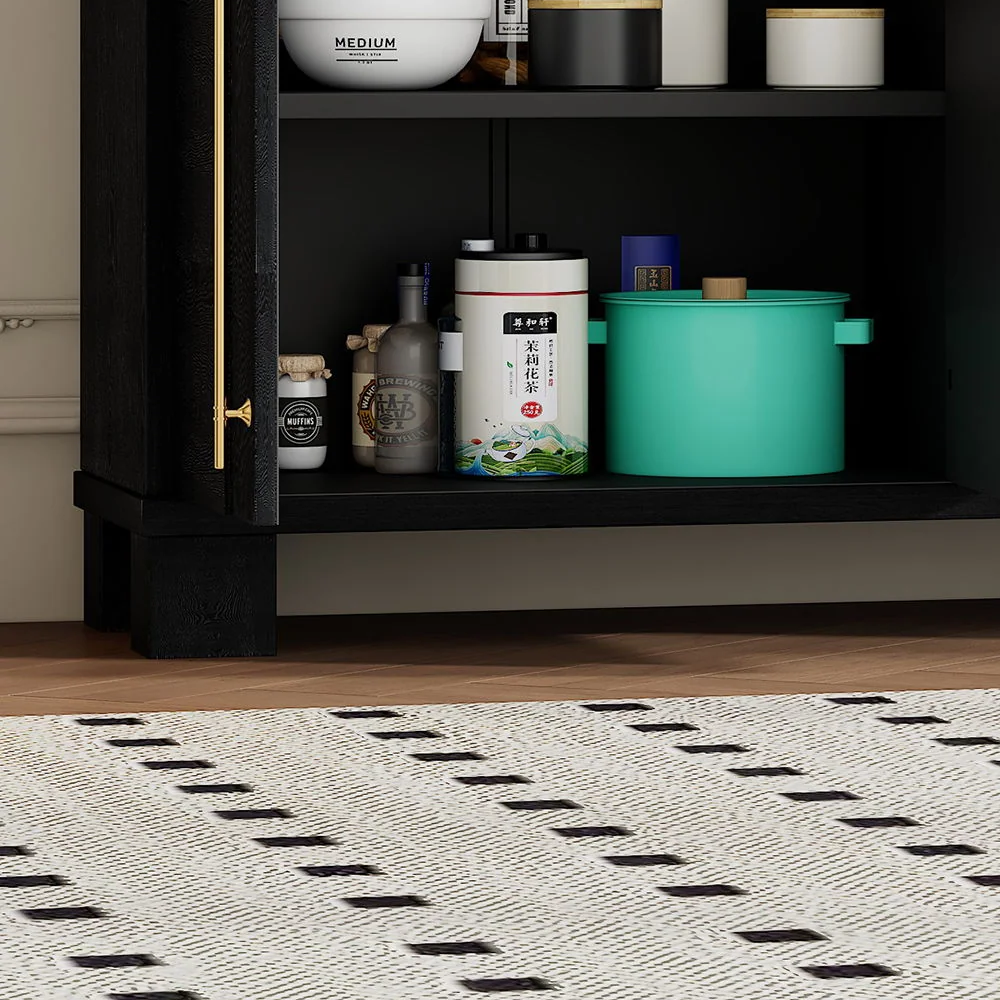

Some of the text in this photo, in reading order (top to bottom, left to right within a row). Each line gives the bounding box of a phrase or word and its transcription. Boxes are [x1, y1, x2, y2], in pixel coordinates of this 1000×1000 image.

[335, 37, 395, 48] MEDIUM
[524, 340, 539, 393] 茉莉花茶
[378, 378, 437, 397] BREWING
[287, 417, 314, 426] MUFFINS
